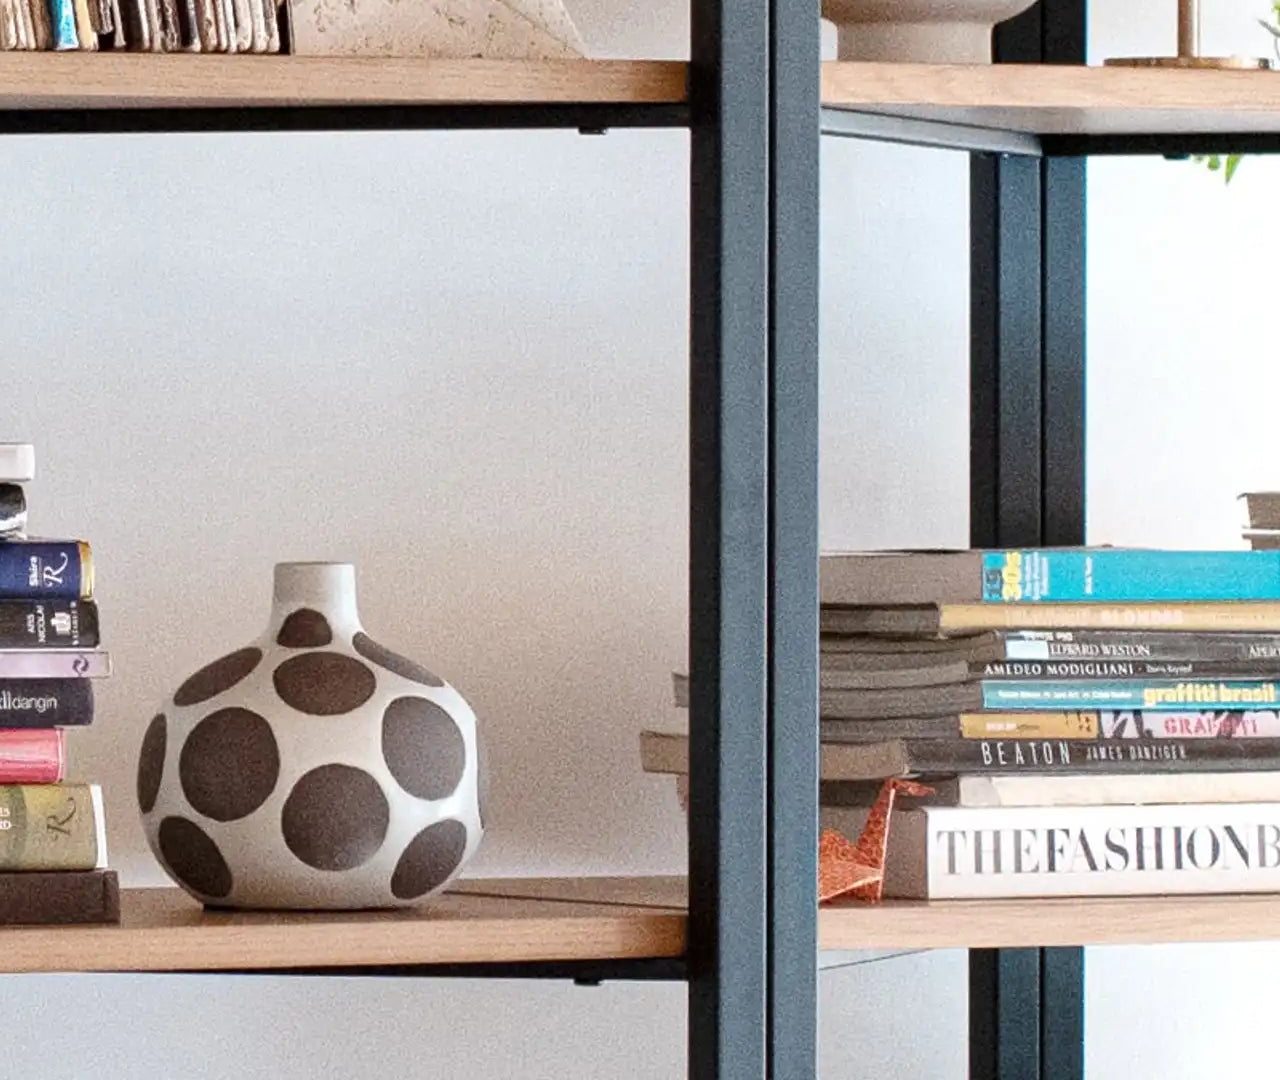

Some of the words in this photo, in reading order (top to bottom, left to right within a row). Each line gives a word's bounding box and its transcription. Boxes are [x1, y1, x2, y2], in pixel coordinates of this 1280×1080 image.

[1100, 643, 1151, 657] WESTON
[983, 663, 1042, 676] AMEDEO
[1047, 663, 1134, 676] MODIGLIANI
[1143, 683, 1217, 707] graffiti
[1218, 683, 1277, 703] brasil
[981, 741, 1071, 766] BEATON
[1086, 747, 1123, 761] JAMES
[1128, 746, 1188, 761] DANZIGER
